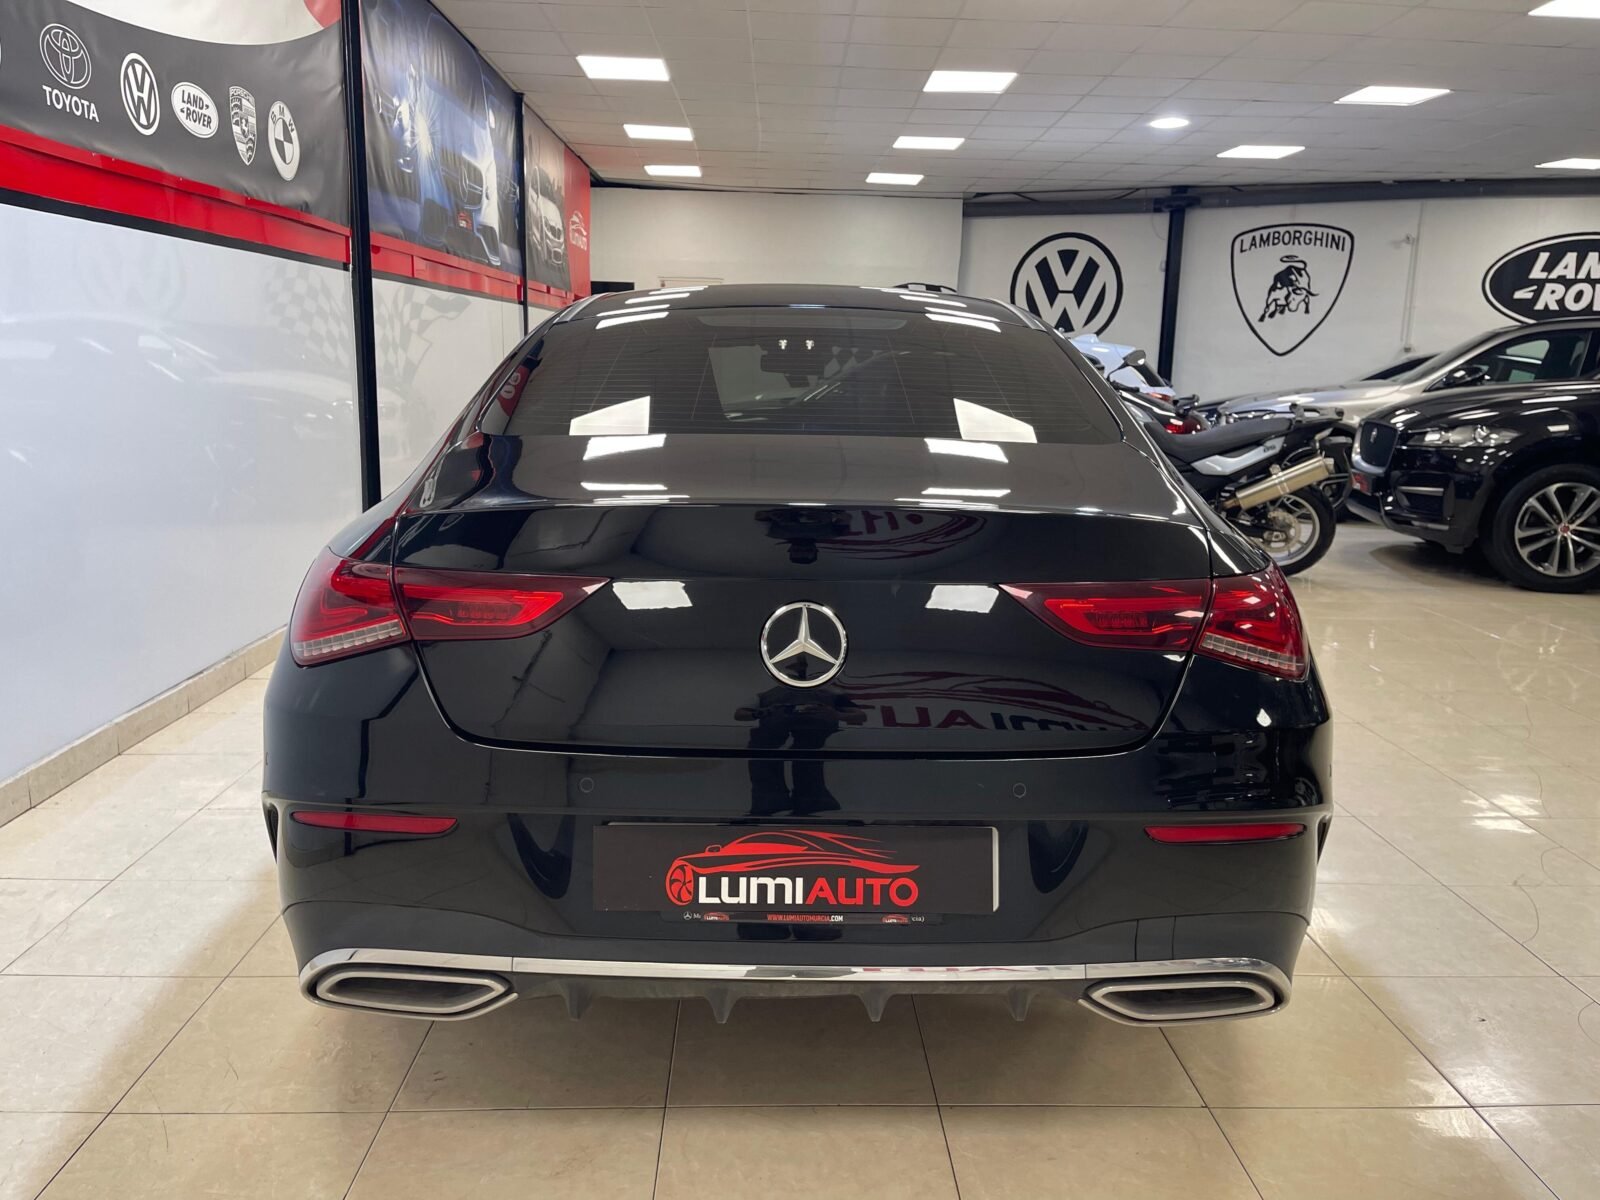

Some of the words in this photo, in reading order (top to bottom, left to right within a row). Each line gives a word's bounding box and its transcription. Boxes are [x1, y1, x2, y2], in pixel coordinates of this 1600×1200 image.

[42, 85, 100, 122] TOYOTA
[181, 89, 205, 111] LAND
[185, 107, 212, 130] ROVER
[1239, 229, 1346, 253] LAMBORGHINI
[698, 876, 919, 907] LUMIAUTO
